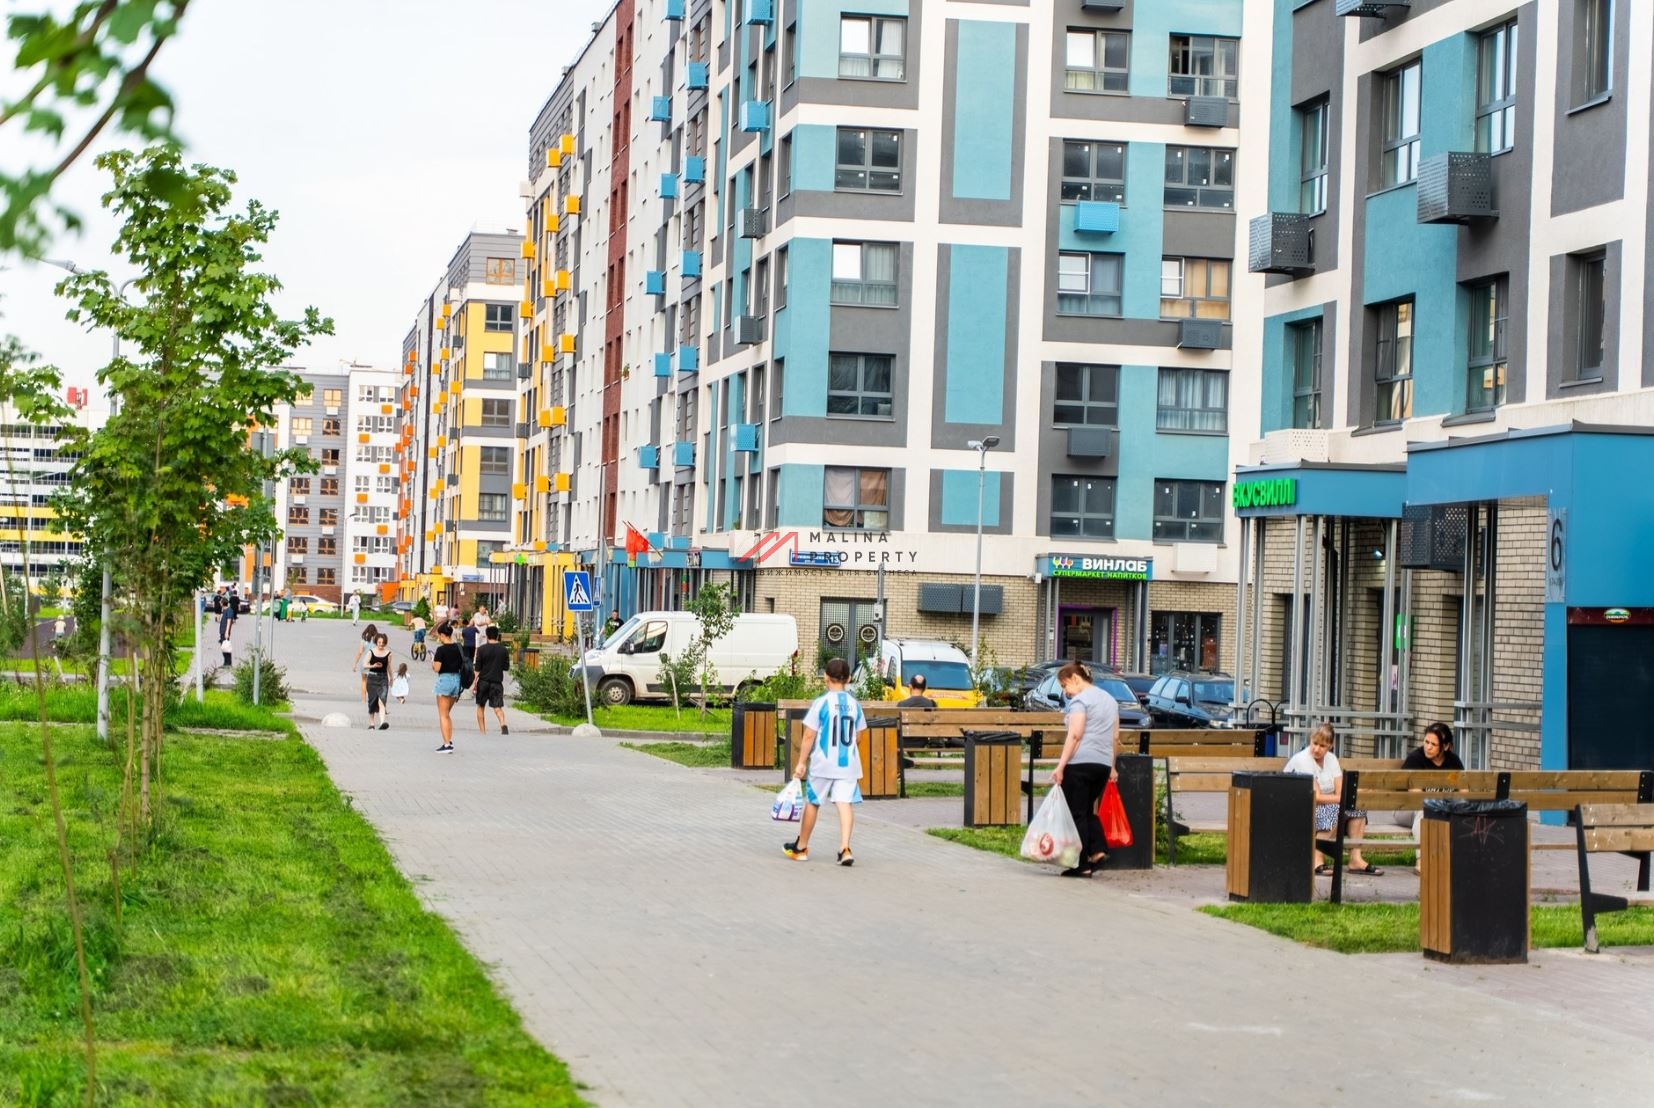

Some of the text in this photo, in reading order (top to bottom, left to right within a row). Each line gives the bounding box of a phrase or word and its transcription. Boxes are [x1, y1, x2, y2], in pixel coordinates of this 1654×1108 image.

[1233, 479, 1295, 507] ВКУСВИЛЛ
[1551, 518, 1562, 571] 6
[1053, 570, 1147, 579] СУПЕРМАРКЕТ НАПИТКОВ
[832, 715, 854, 747] 10
